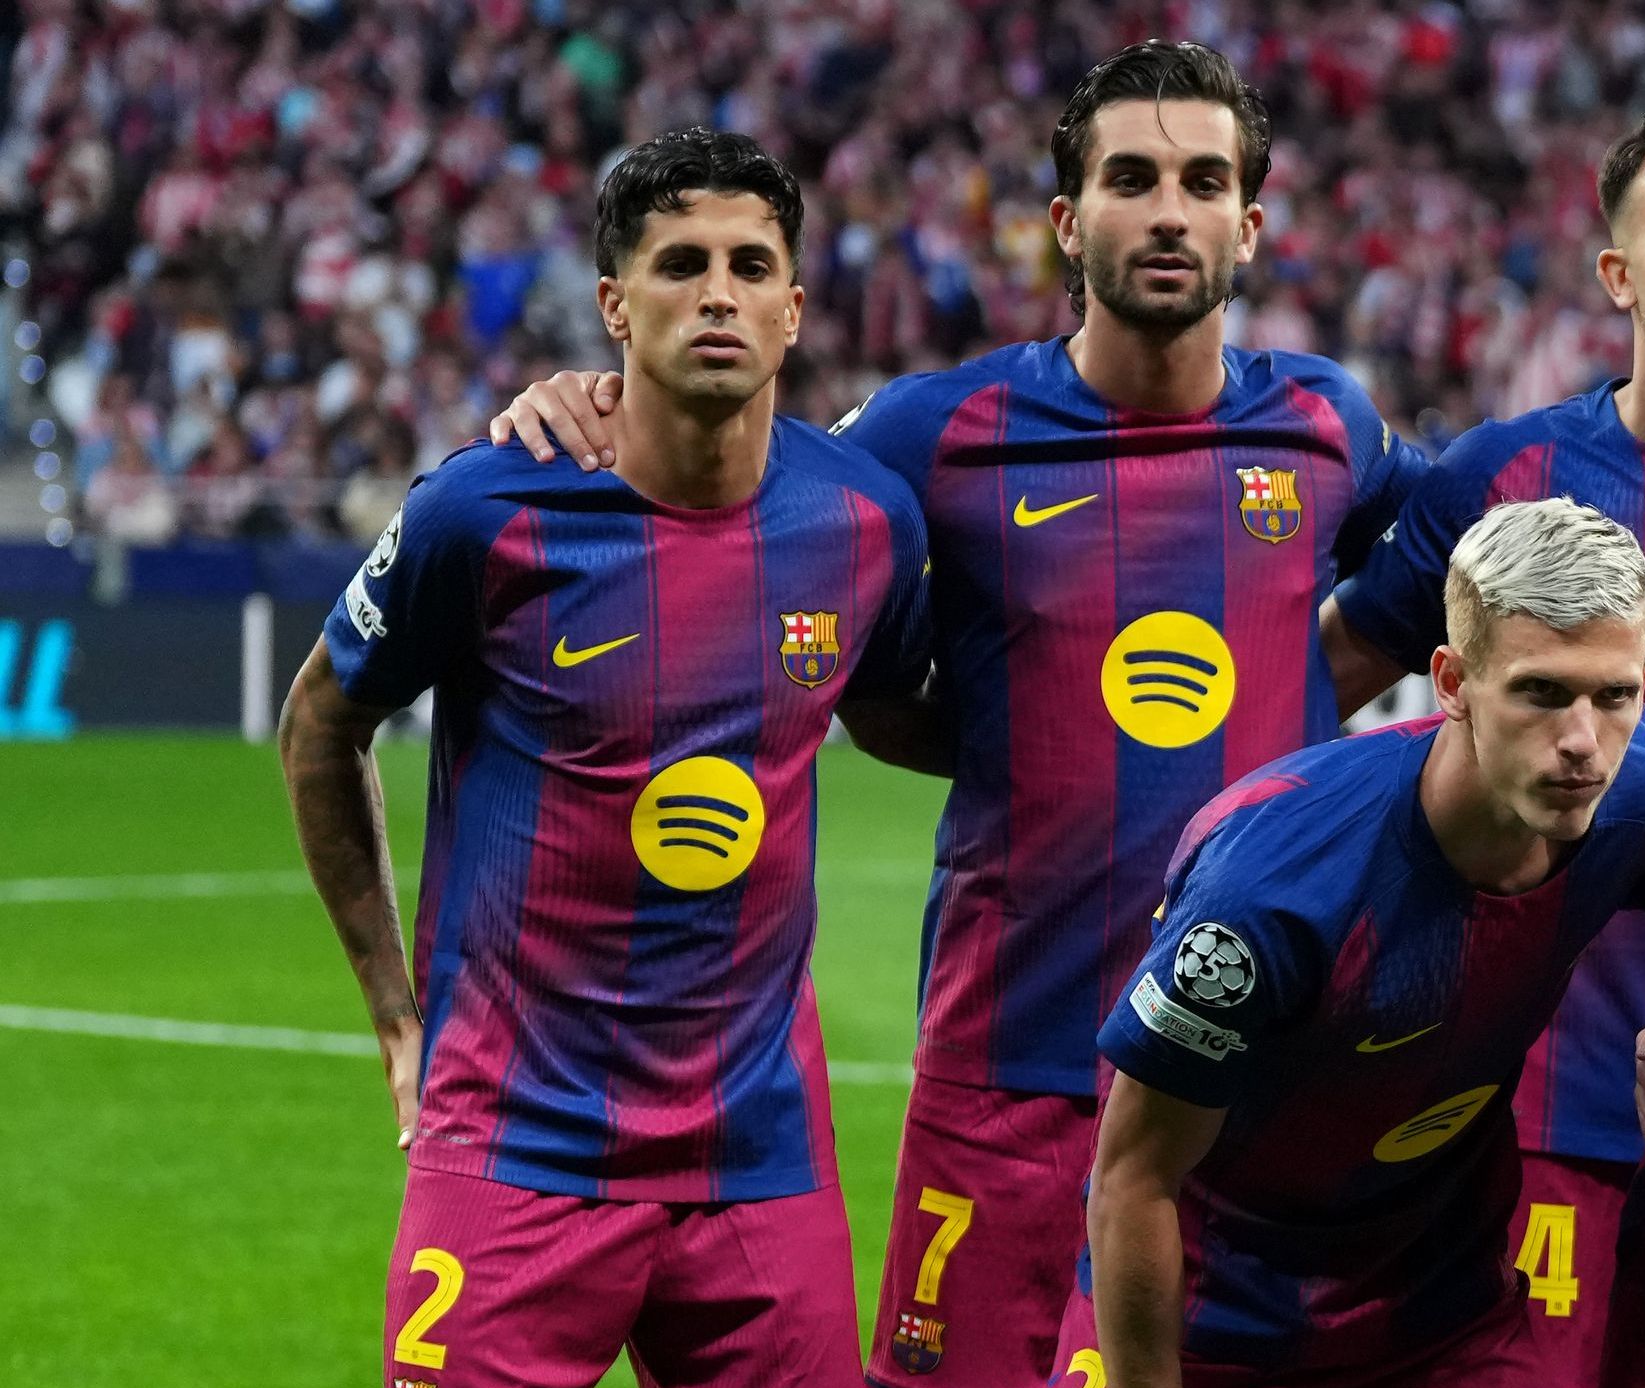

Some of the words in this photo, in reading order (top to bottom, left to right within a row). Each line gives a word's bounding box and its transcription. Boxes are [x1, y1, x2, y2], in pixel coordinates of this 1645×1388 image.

[1260, 500, 1284, 509] FCB
[800, 644, 823, 653] FCB
[1200, 951, 1227, 982] 5
[917, 1186, 974, 1306] 7
[1514, 1203, 1579, 1317] 4
[393, 1247, 466, 1370] 2
